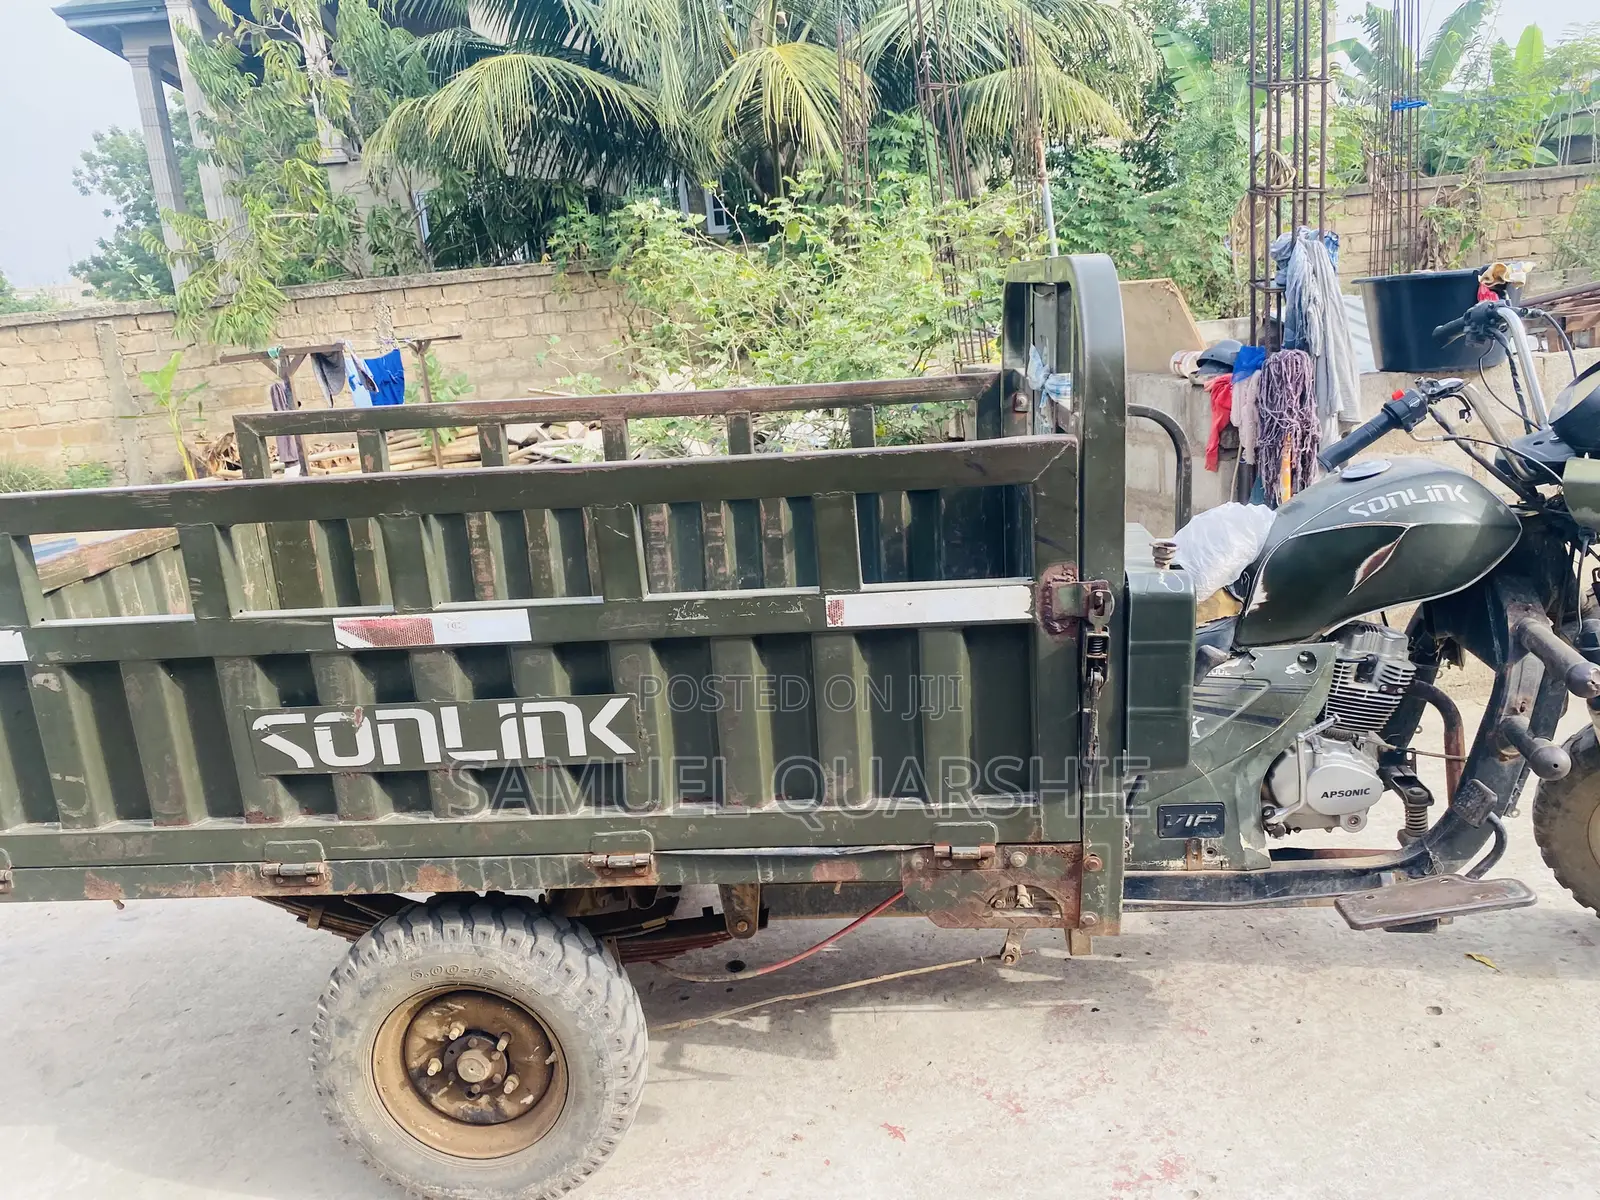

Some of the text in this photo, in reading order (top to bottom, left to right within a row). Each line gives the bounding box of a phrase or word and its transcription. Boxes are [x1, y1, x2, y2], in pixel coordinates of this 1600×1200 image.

[1348, 484, 1469, 517] SONLINK
[251, 697, 637, 769] SONLINK
[1320, 787, 1371, 799] APSONIC
[1164, 813, 1218, 827] VIP
